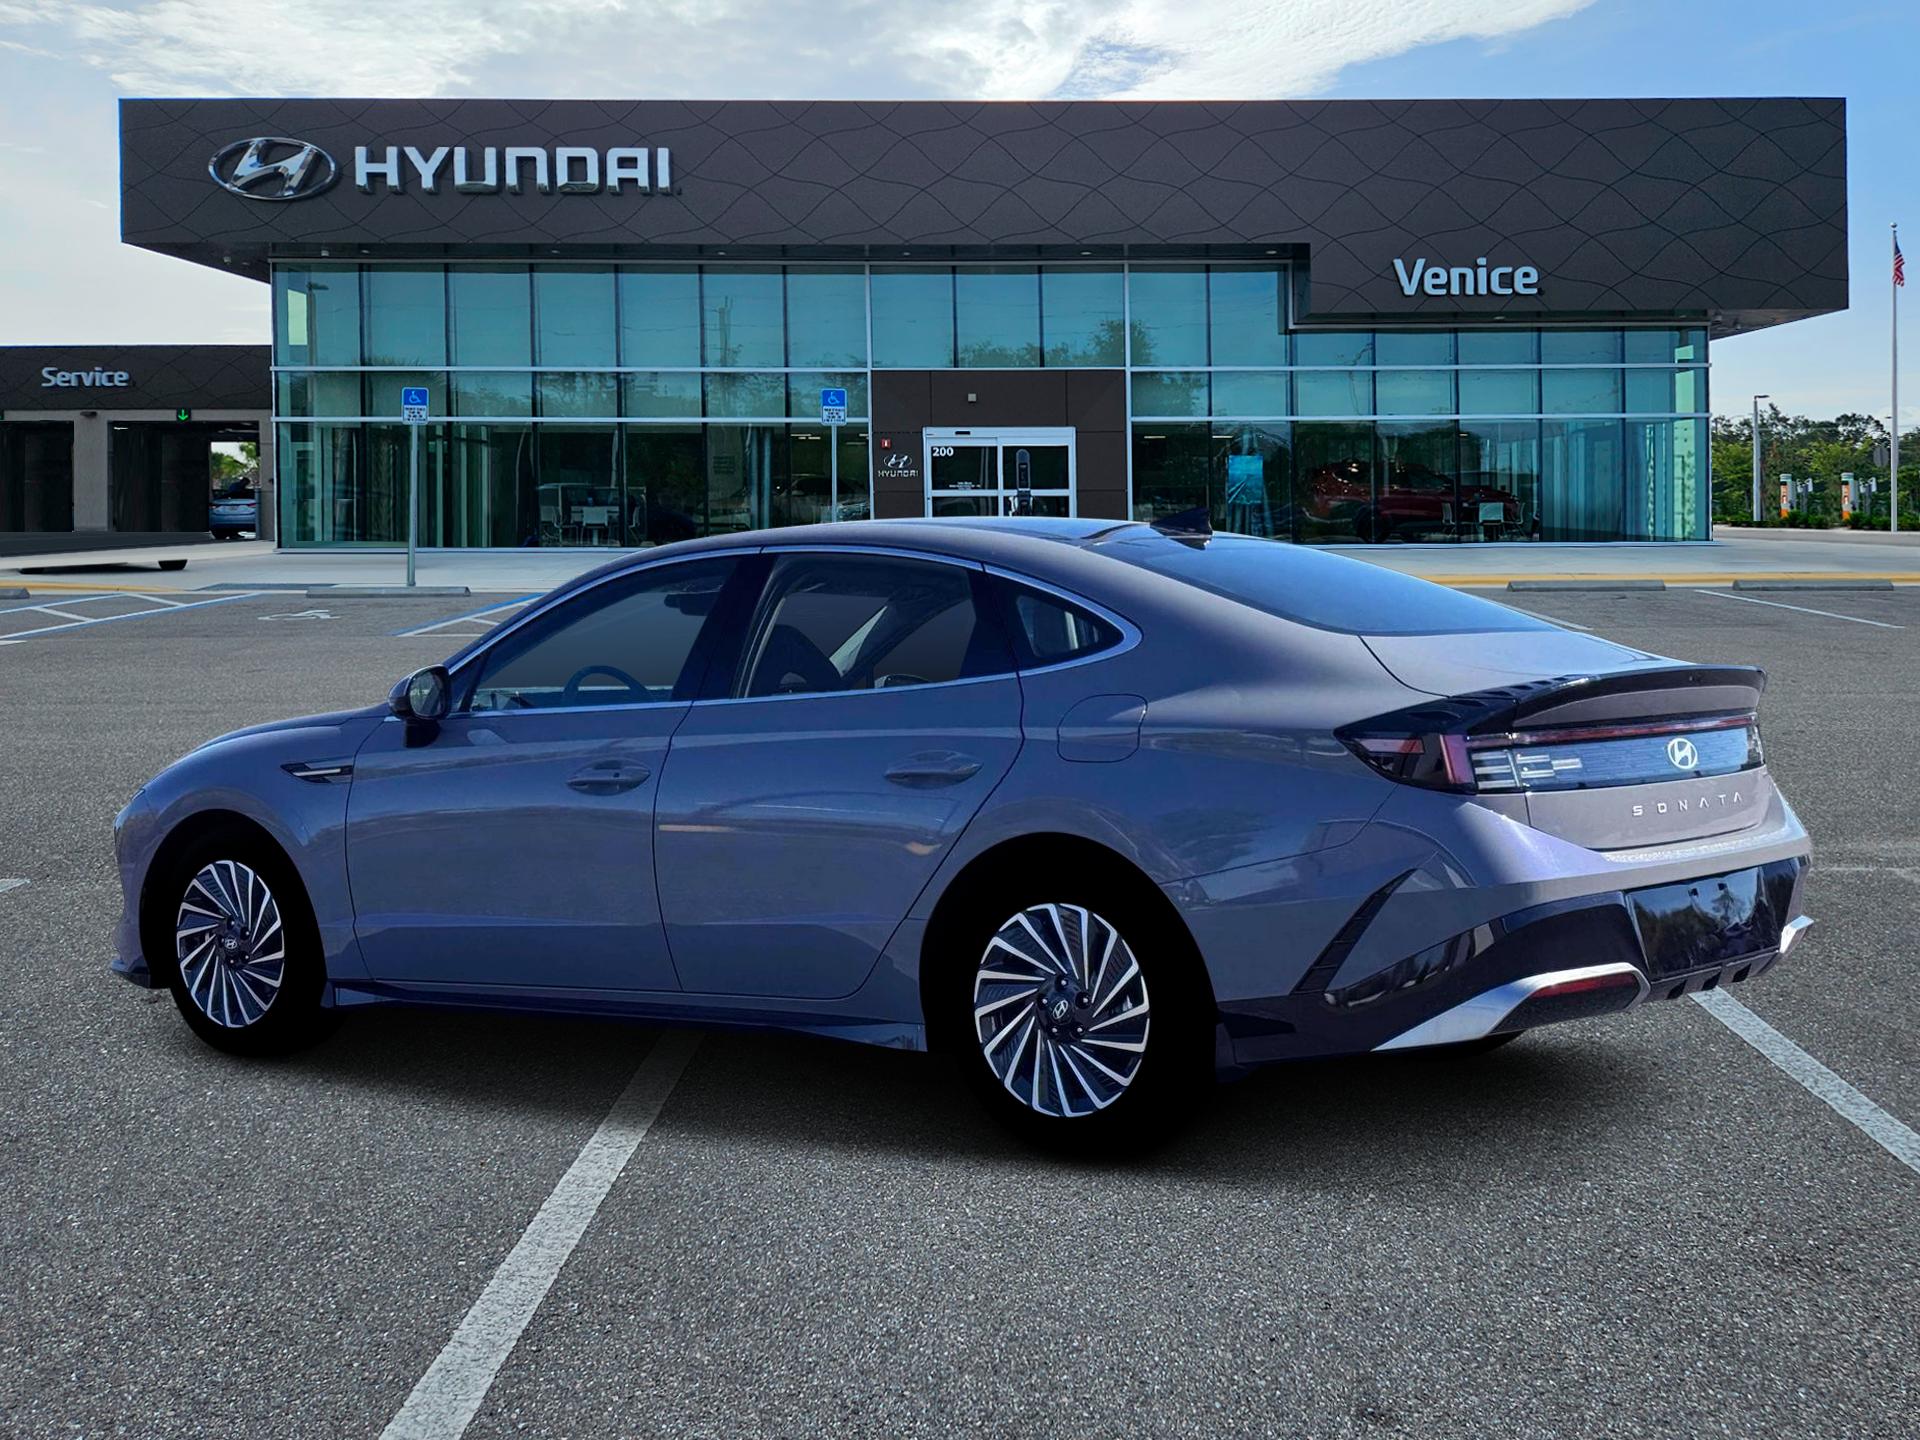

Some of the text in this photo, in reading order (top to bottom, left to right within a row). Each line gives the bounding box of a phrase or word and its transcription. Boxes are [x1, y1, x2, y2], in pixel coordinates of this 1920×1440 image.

[354, 146, 671, 194] HYUNDAI
[1393, 257, 1539, 296] Venice
[41, 366, 130, 387] Service
[932, 447, 954, 457] 200
[878, 469, 919, 478] HYUNDAI
[1632, 791, 1742, 816] SONATA
